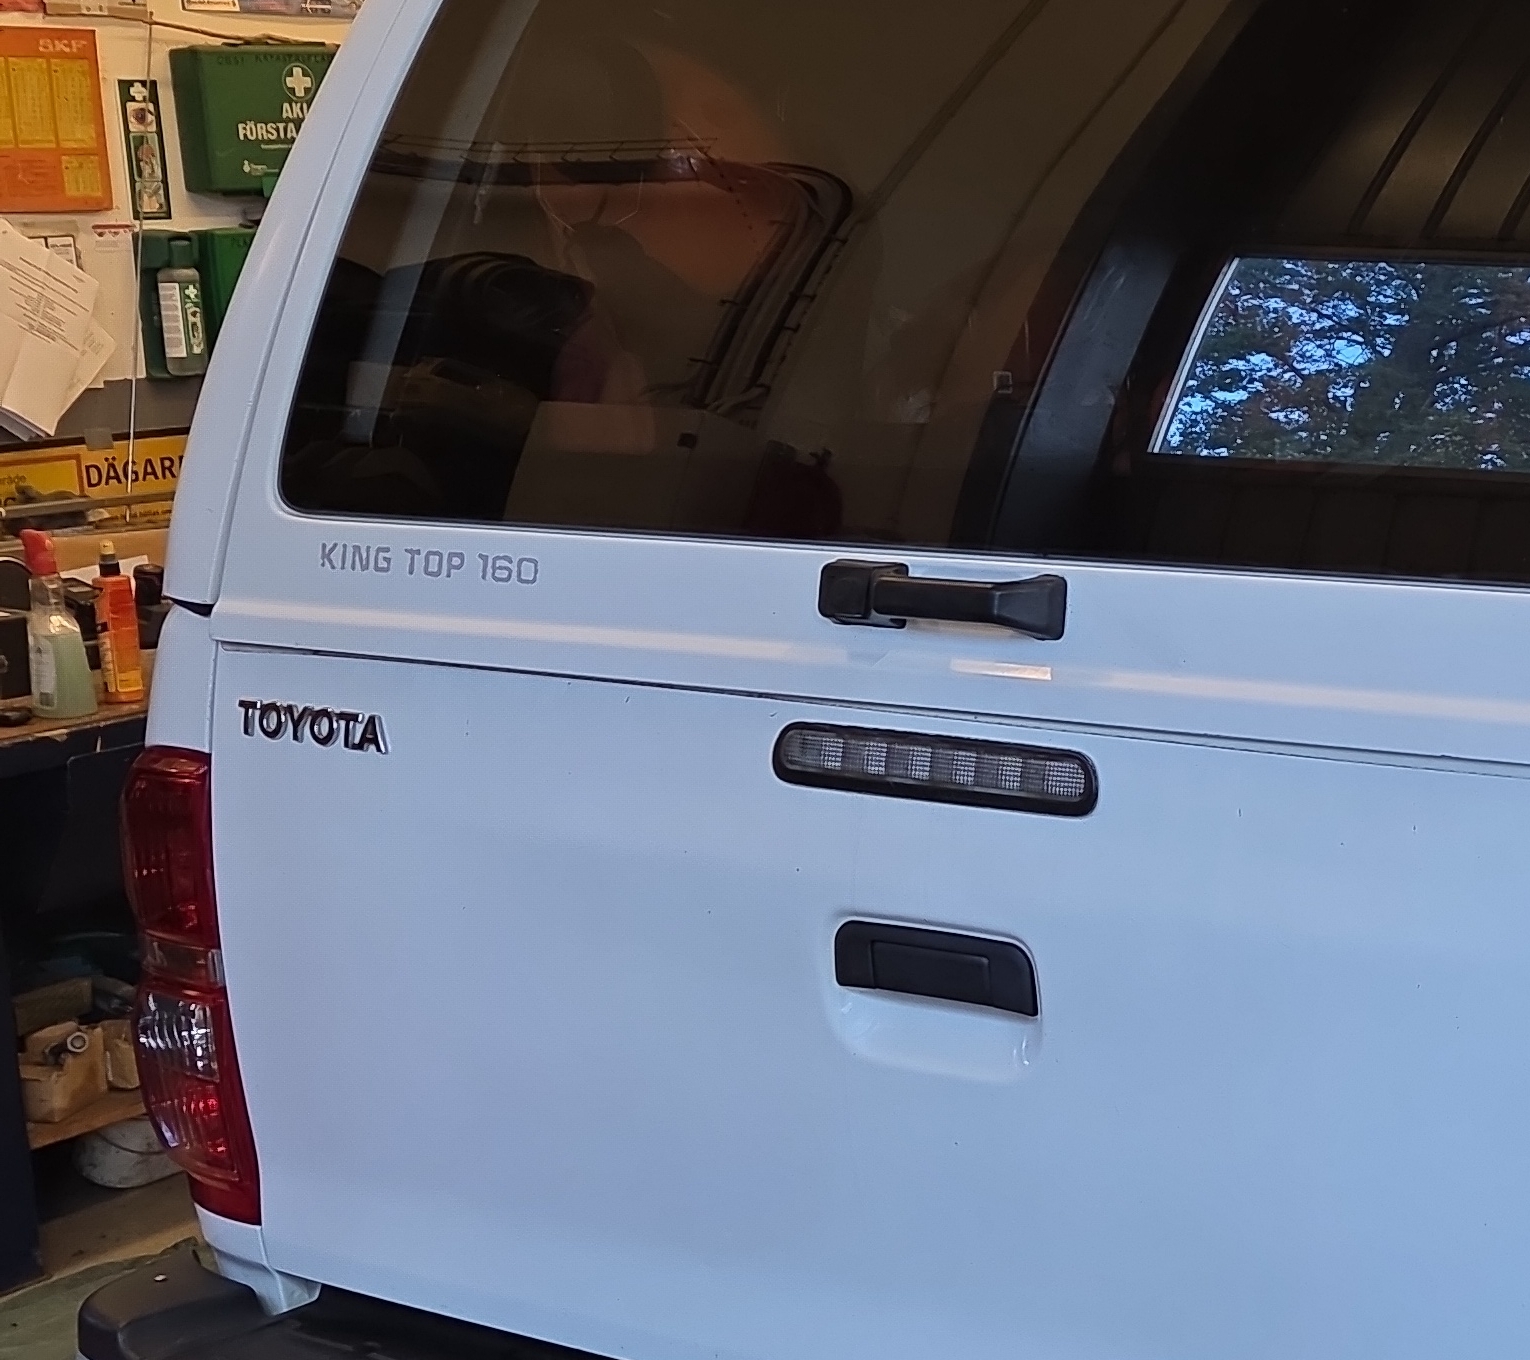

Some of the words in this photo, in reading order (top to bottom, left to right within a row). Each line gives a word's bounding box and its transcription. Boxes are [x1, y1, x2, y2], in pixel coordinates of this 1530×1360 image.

[38, 38, 88, 53] SKF
[237, 120, 298, 141] FÖRSTA
[84, 454, 186, 489] DÄGAR
[320, 541, 393, 574] KING
[404, 547, 466, 580] TOP
[476, 552, 541, 587] 160
[237, 698, 390, 756] TOYOTA
